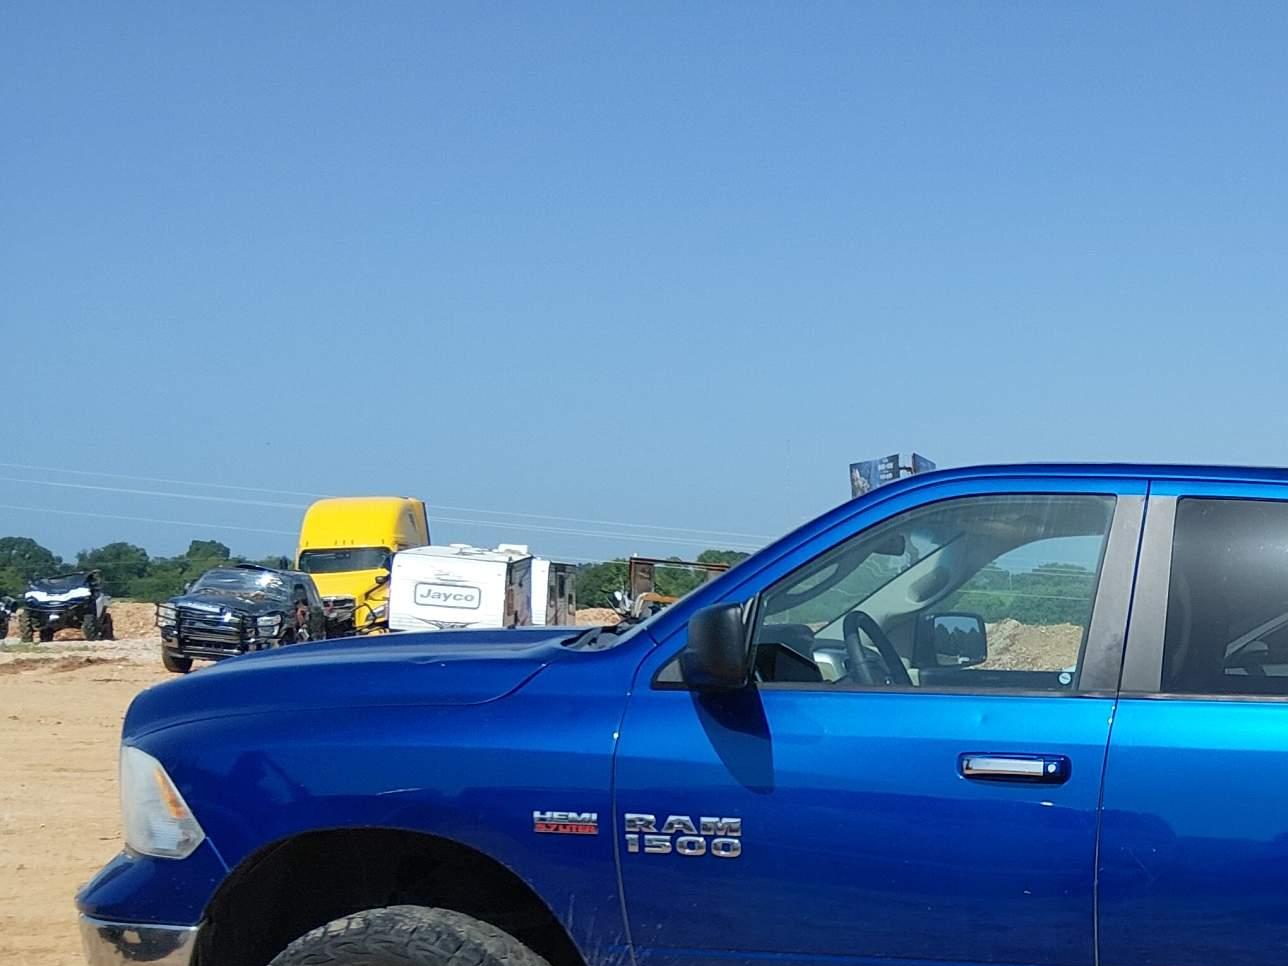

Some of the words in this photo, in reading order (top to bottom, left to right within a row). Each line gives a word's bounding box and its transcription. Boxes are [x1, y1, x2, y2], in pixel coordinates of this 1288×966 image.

[419, 588, 475, 603] Jayco
[533, 810, 598, 823] HEMI
[624, 813, 742, 836] RAM
[624, 834, 742, 858] 1500
